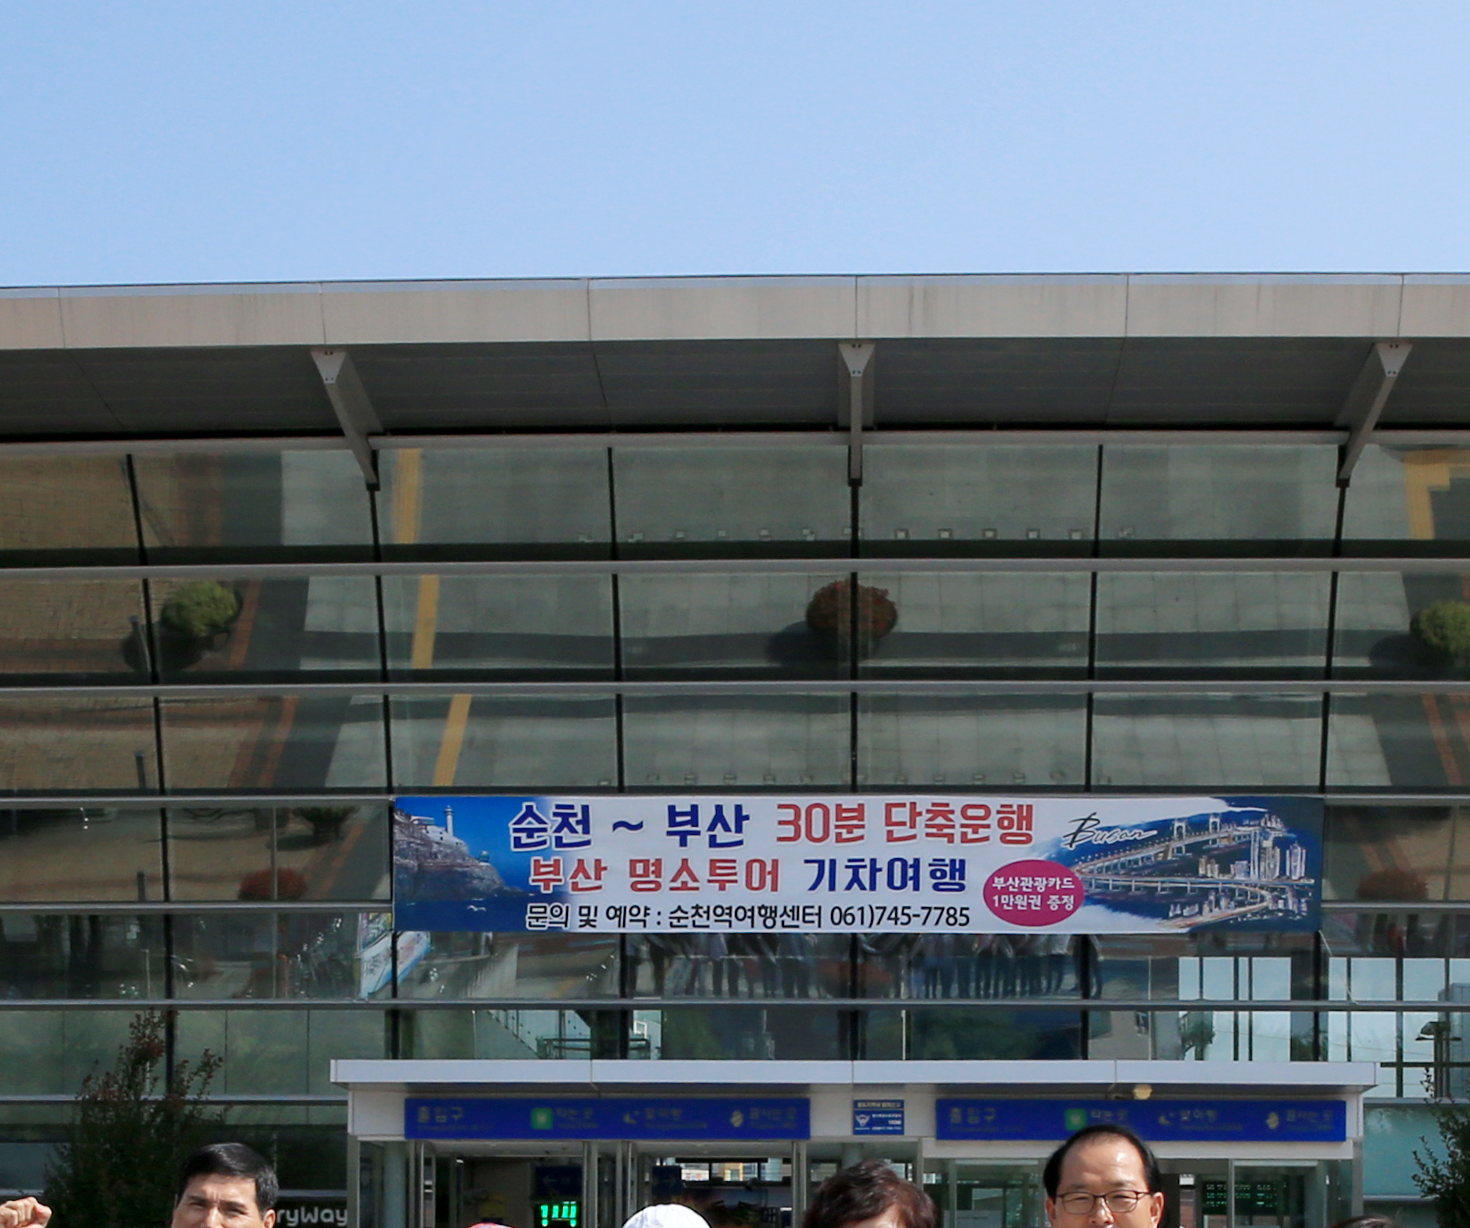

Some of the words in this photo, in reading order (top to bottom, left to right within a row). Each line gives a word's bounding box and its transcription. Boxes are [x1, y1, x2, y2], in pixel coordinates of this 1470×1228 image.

[511, 803, 592, 849] 순천
[666, 803, 750, 849] 부산
[776, 802, 866, 844] 30분
[884, 801, 1034, 845] 단축운행
[1062, 812, 1158, 849] Busan
[532, 858, 608, 892] 부산
[629, 858, 779, 892] 명소투어
[803, 857, 967, 892] 기차여행
[992, 876, 1075, 891] 부산관광카드
[527, 904, 570, 929] 문의
[579, 904, 598, 928] 및
[606, 904, 651, 927] 예약
[669, 904, 821, 929] 순천역여행센터
[830, 904, 970, 929] 061)745-7785
[993, 895, 1042, 910] 1만원권
[1047, 895, 1075, 911] 증정
